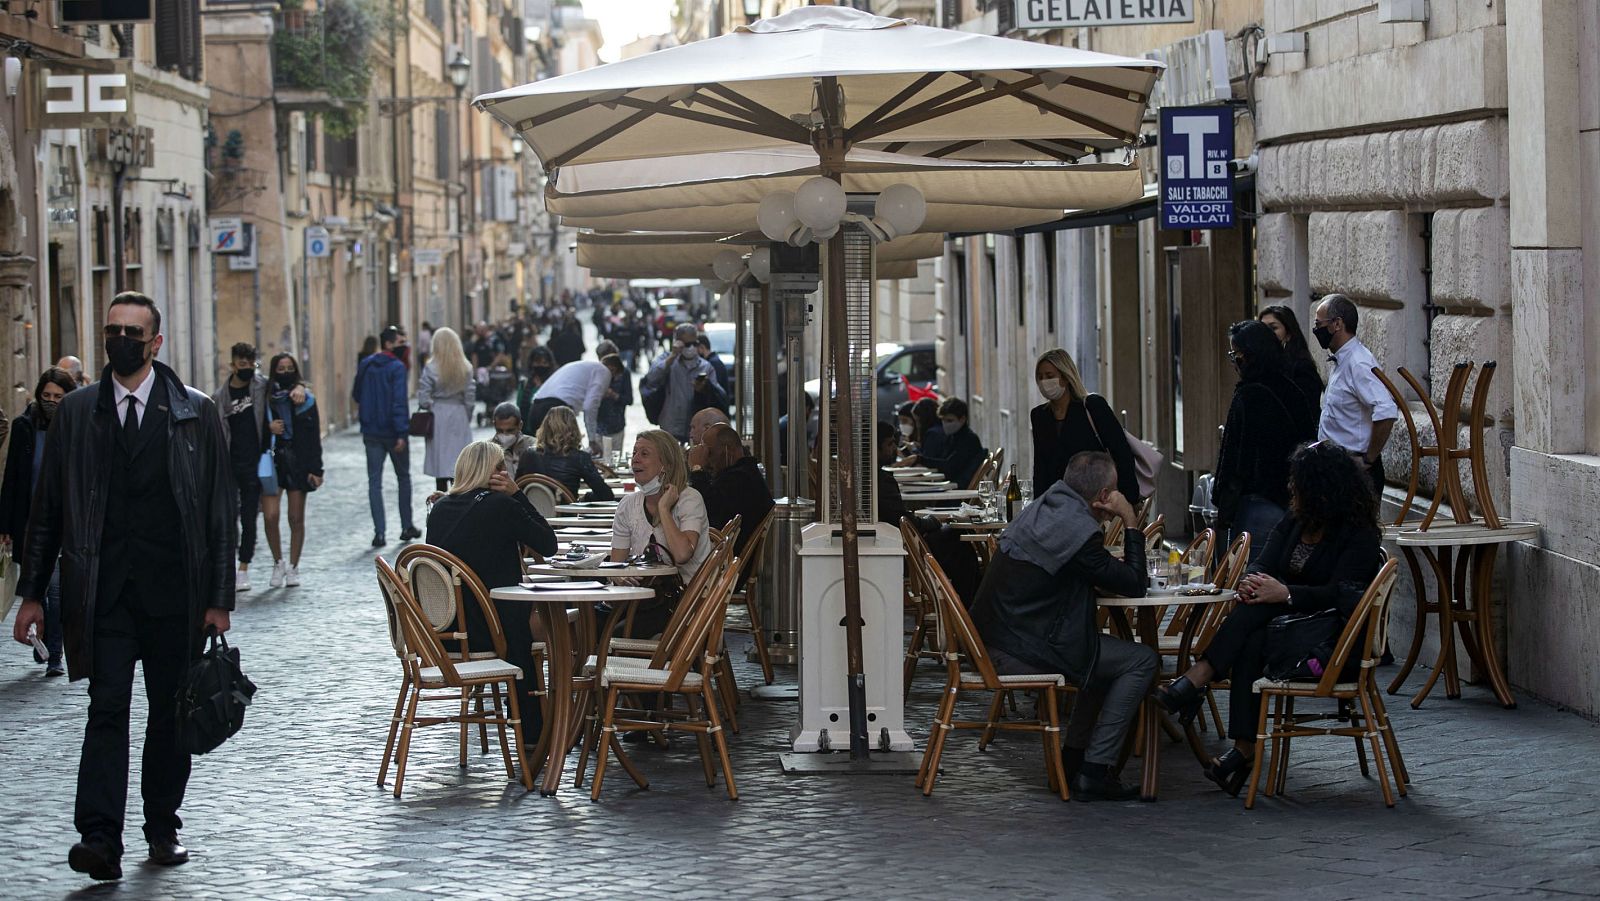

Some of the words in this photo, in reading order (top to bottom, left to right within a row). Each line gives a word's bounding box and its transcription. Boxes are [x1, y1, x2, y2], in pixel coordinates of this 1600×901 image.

[1028, 0, 1186, 22] GELATERIA
[1173, 116, 1219, 178] T
[1214, 165, 1221, 174] 8
[1168, 187, 1184, 200] SALI
[1186, 187, 1191, 200] E
[1193, 186, 1228, 200] TABACCHI
[1172, 204, 1226, 214] VALORI
[1168, 214, 1230, 224] BOLLATI
